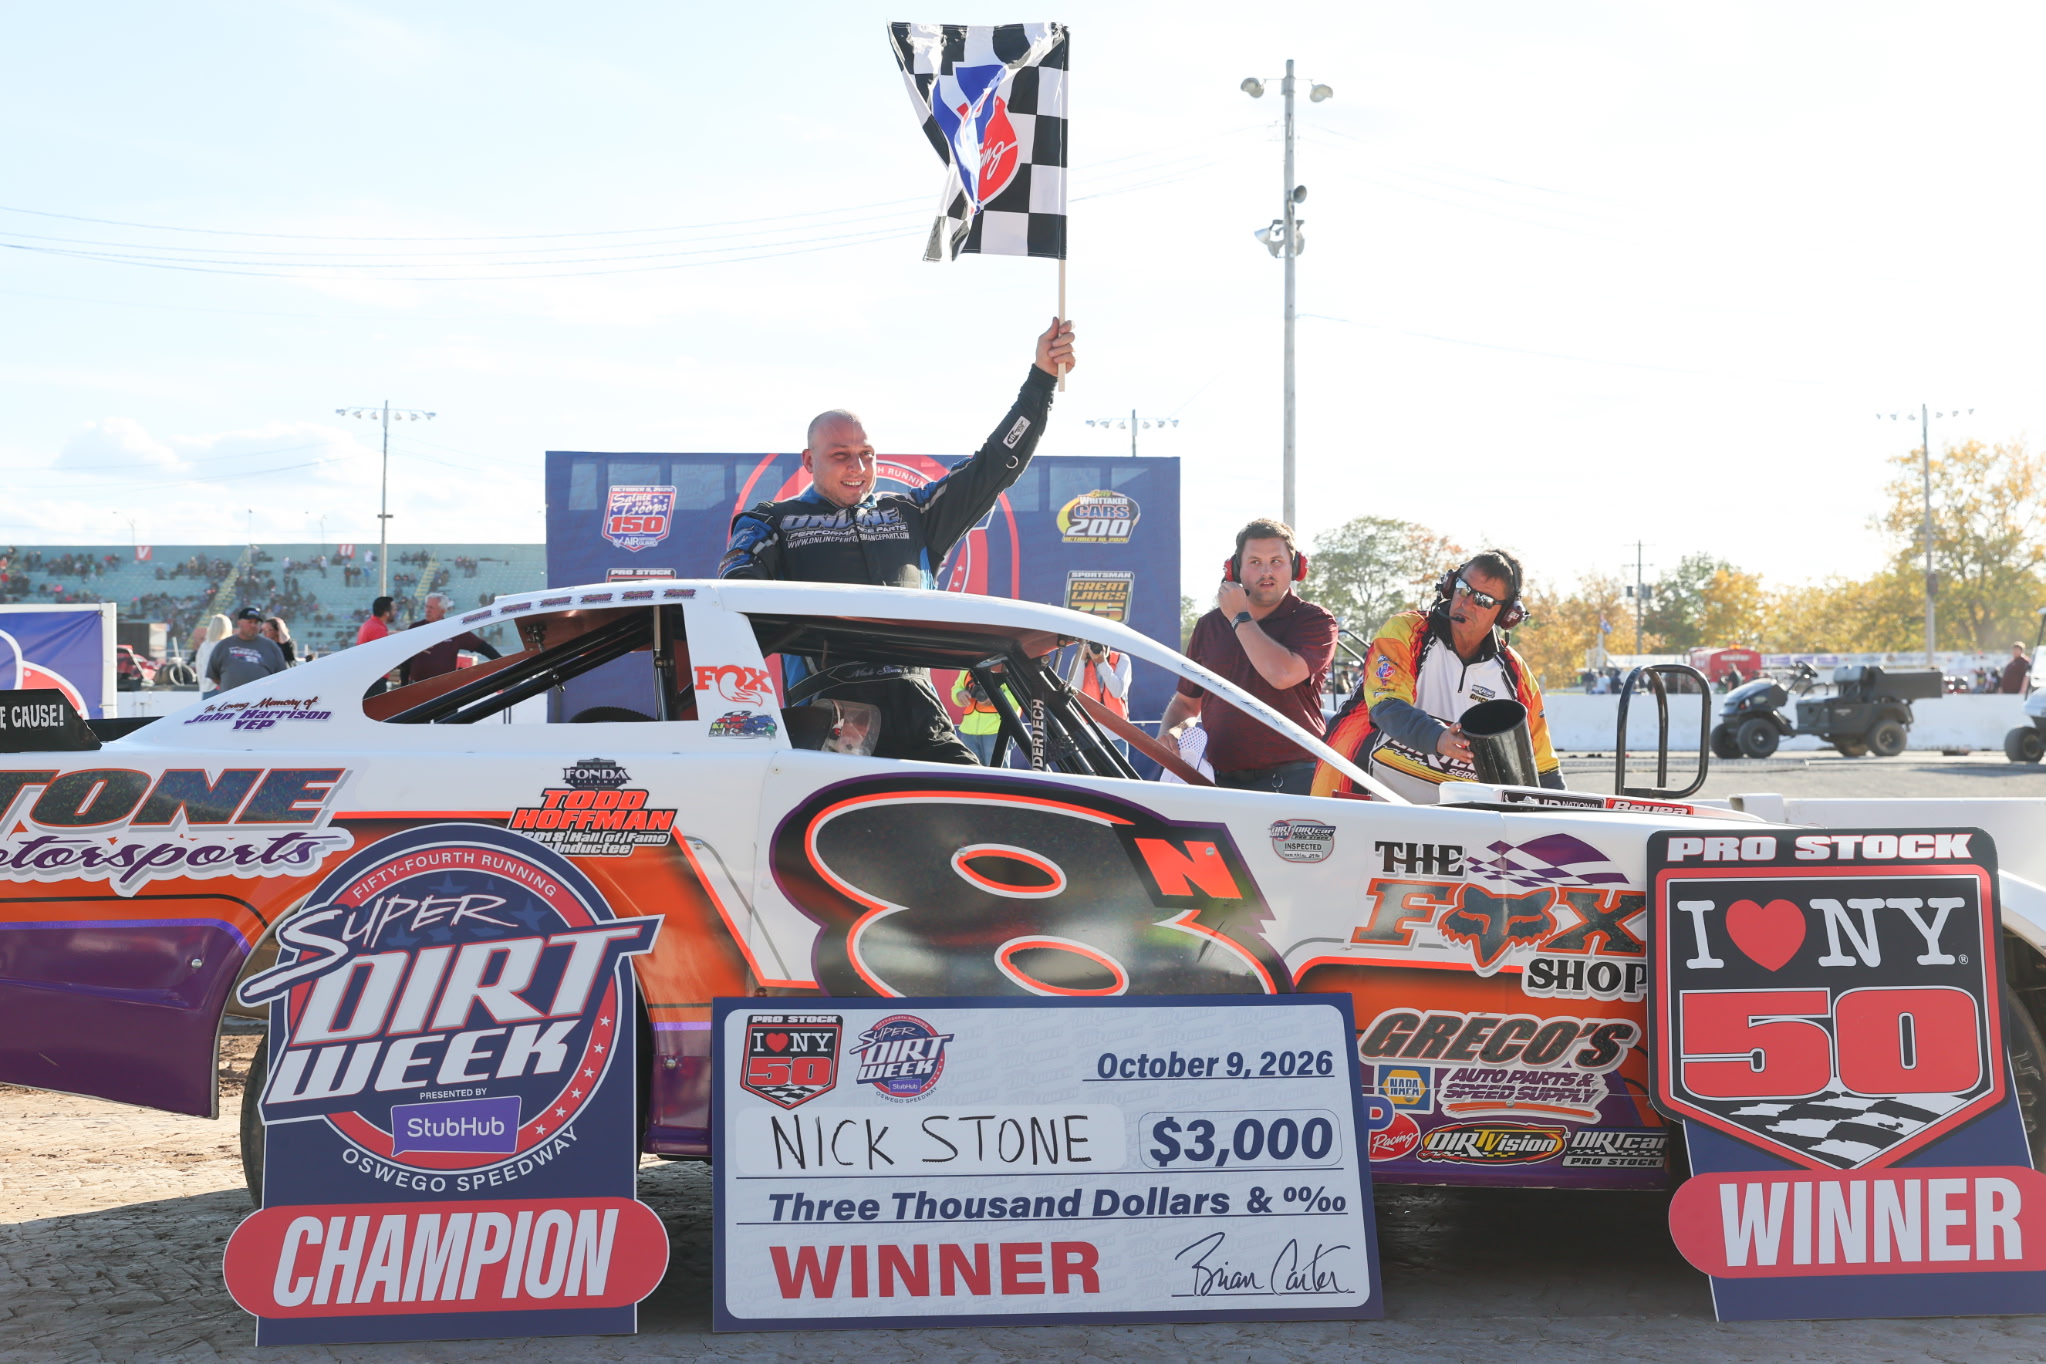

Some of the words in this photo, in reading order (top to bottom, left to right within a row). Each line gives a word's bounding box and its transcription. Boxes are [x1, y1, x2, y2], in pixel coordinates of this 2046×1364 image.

[1074, 504, 1130, 518] CARS
[1080, 496, 1128, 505] WHITTAKER
[610, 516, 664, 533] 150
[875, 522, 909, 533] PARTS
[1066, 519, 1131, 536] 200
[624, 537, 639, 546] AIR
[1071, 592, 1127, 600] LAKES
[1072, 582, 1127, 591] GREAT
[694, 665, 773, 706] FOX
[217, 701, 250, 711] Loving
[251, 697, 301, 709] Memory
[303, 696, 319, 710] of
[12, 704, 64, 728] CAUSE!
[184, 711, 235, 724] John
[238, 709, 332, 720] Harrison
[232, 720, 276, 729] YEP
[565, 769, 628, 780] FONDA
[543, 790, 648, 809] TODD
[511, 809, 675, 830] HOFFMAN
[569, 831, 602, 843] Hall
[604, 832, 624, 843] of
[627, 832, 667, 843] Fame
[1284, 842, 1322, 850] INSPECTED
[558, 843, 633, 855] Inductee
[1374, 840, 1463, 877] THE
[1666, 835, 1777, 863] PRO
[1794, 833, 1974, 861] STOCK
[352, 851, 476, 899] FIFTY-FOURTH
[481, 854, 557, 898] RUNNING
[800, 786, 1281, 997] 8
[1134, 838, 1243, 899] N
[1676, 900, 1725, 970] I
[1809, 896, 1966, 969] NY
[243, 894, 519, 997] SUPER
[289, 925, 643, 1047] DIRT
[788, 1015, 838, 1023] STOCK
[753, 1033, 765, 1052] I
[790, 1032, 833, 1052] NY
[850, 1026, 919, 1053] SUPER
[1360, 1011, 1636, 1068] GRECO'S
[1679, 985, 1984, 1101] 50
[863, 1035, 951, 1066] DIRT
[265, 1019, 582, 1105] WEEK
[749, 1057, 832, 1086] 50
[857, 1059, 936, 1080] WEEK
[1097, 1051, 1219, 1079] October
[1226, 1051, 1252, 1079] 9,
[1259, 1050, 1334, 1076] 2026
[1390, 1077, 1420, 1096] NAPA
[1450, 1067, 1510, 1084] AUTO
[1507, 1069, 1577, 1086] PARTS
[1576, 1073, 1595, 1087] &
[419, 1088, 468, 1100] PRESENTED
[470, 1087, 488, 1097] BY
[875, 1091, 904, 1104] OSWEGO
[905, 1087, 937, 1104] SPEEDWAY
[1443, 1082, 1512, 1100] SPEED
[1511, 1084, 1600, 1103] SUPPLY
[406, 1116, 506, 1137] StubHub
[771, 1114, 895, 1170] NICK
[922, 1114, 1092, 1165] STONE
[1149, 1116, 1334, 1168] $3,000
[1372, 1131, 1420, 1154] Racing
[1570, 1131, 1667, 1153] DIRTcar
[342, 1147, 446, 1193] OSWEGO
[456, 1125, 579, 1193] SPEEDWAY
[1570, 1157, 1603, 1166] PRO
[1607, 1158, 1659, 1167] STOCK
[769, 1192, 880, 1222] Three
[891, 1188, 1083, 1220] Thousand
[1092, 1186, 1230, 1217] Dollars
[1246, 1186, 1273, 1213] &
[1719, 1177, 2023, 1268] WINNER
[273, 1208, 620, 1308] CHAMPION
[1175, 1231, 1265, 1297] Brian
[1270, 1238, 1351, 1297] Carter
[769, 1240, 1101, 1300] WINNER
